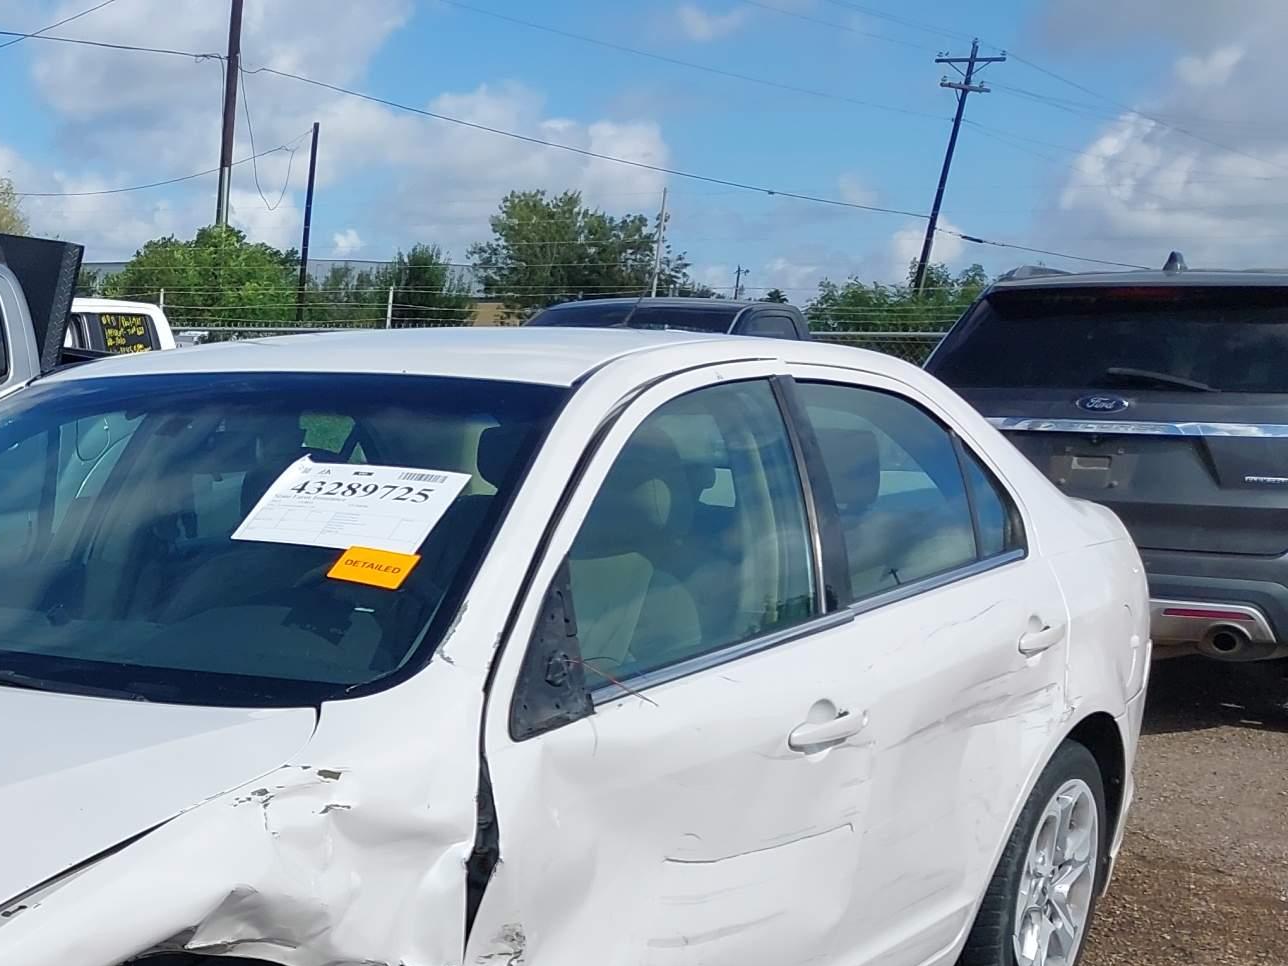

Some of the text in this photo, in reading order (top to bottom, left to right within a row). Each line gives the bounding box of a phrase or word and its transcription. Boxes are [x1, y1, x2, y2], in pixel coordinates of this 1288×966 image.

[1085, 397, 1116, 409] Ford
[290, 480, 435, 504] 43289725
[344, 559, 401, 574] DETAILED
